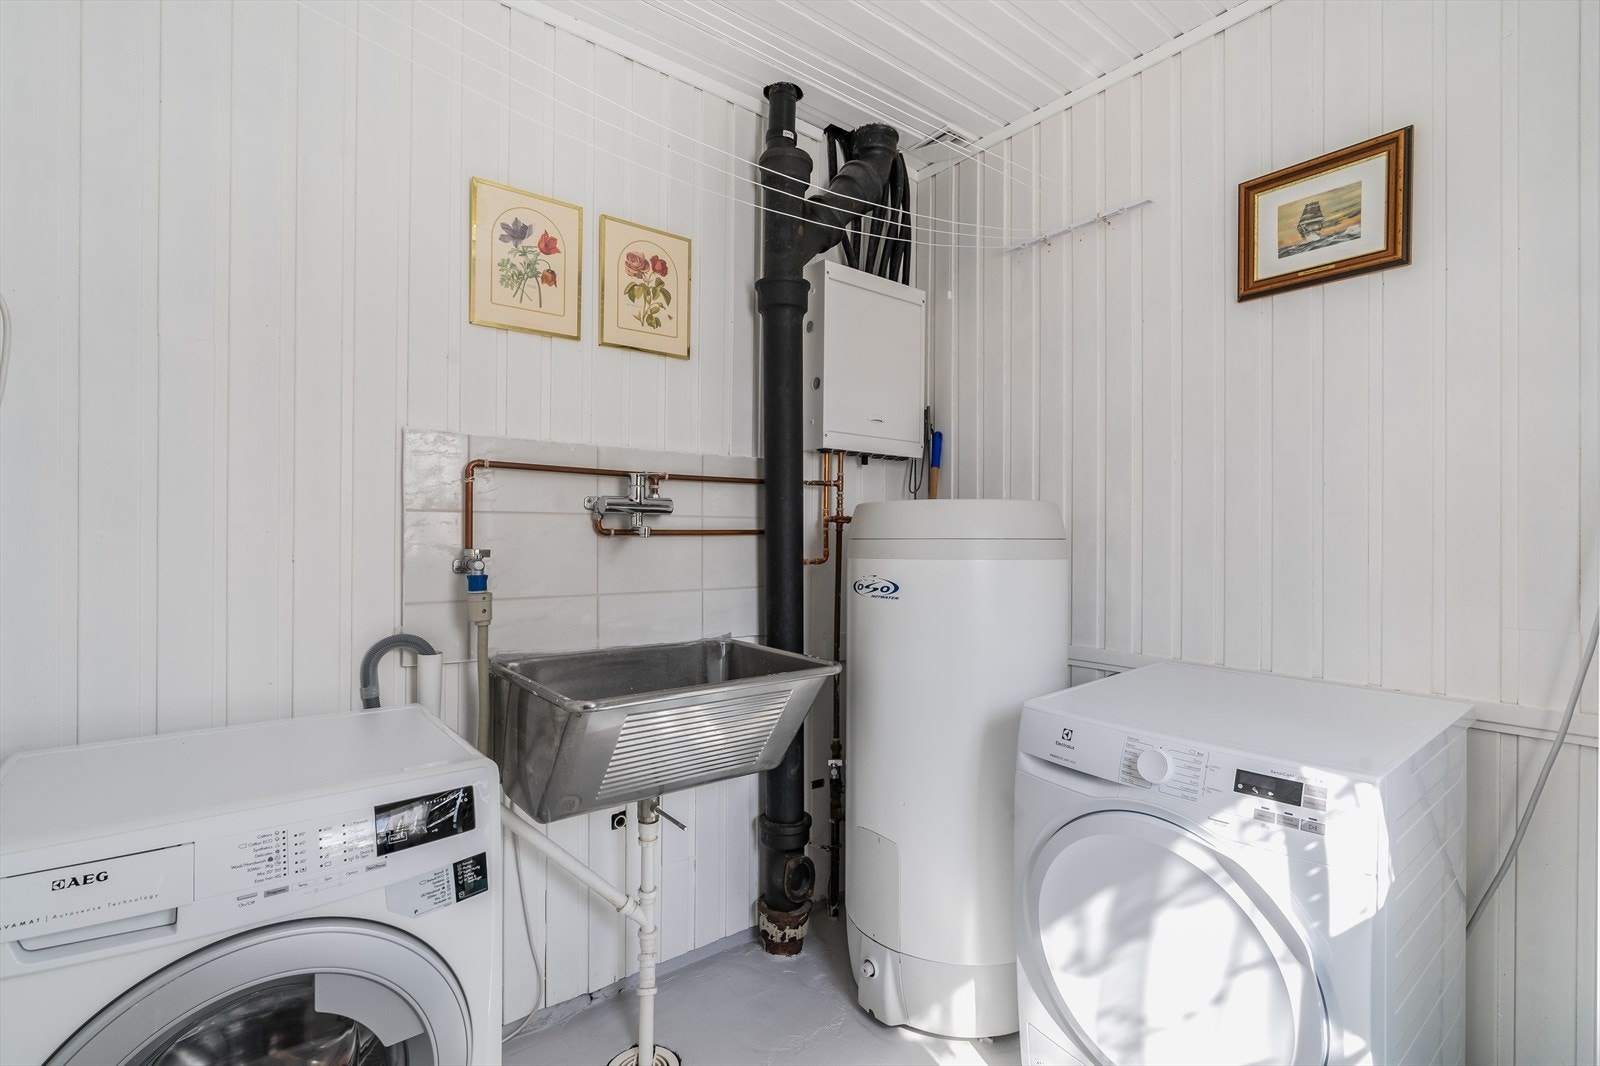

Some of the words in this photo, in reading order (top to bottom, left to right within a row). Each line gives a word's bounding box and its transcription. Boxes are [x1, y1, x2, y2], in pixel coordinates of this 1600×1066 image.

[1056, 740, 1075, 750] Electrolux
[67, 871, 109, 888] AEG
[52, 905, 101, 919] Autosense
[107, 893, 159, 907] Technology
